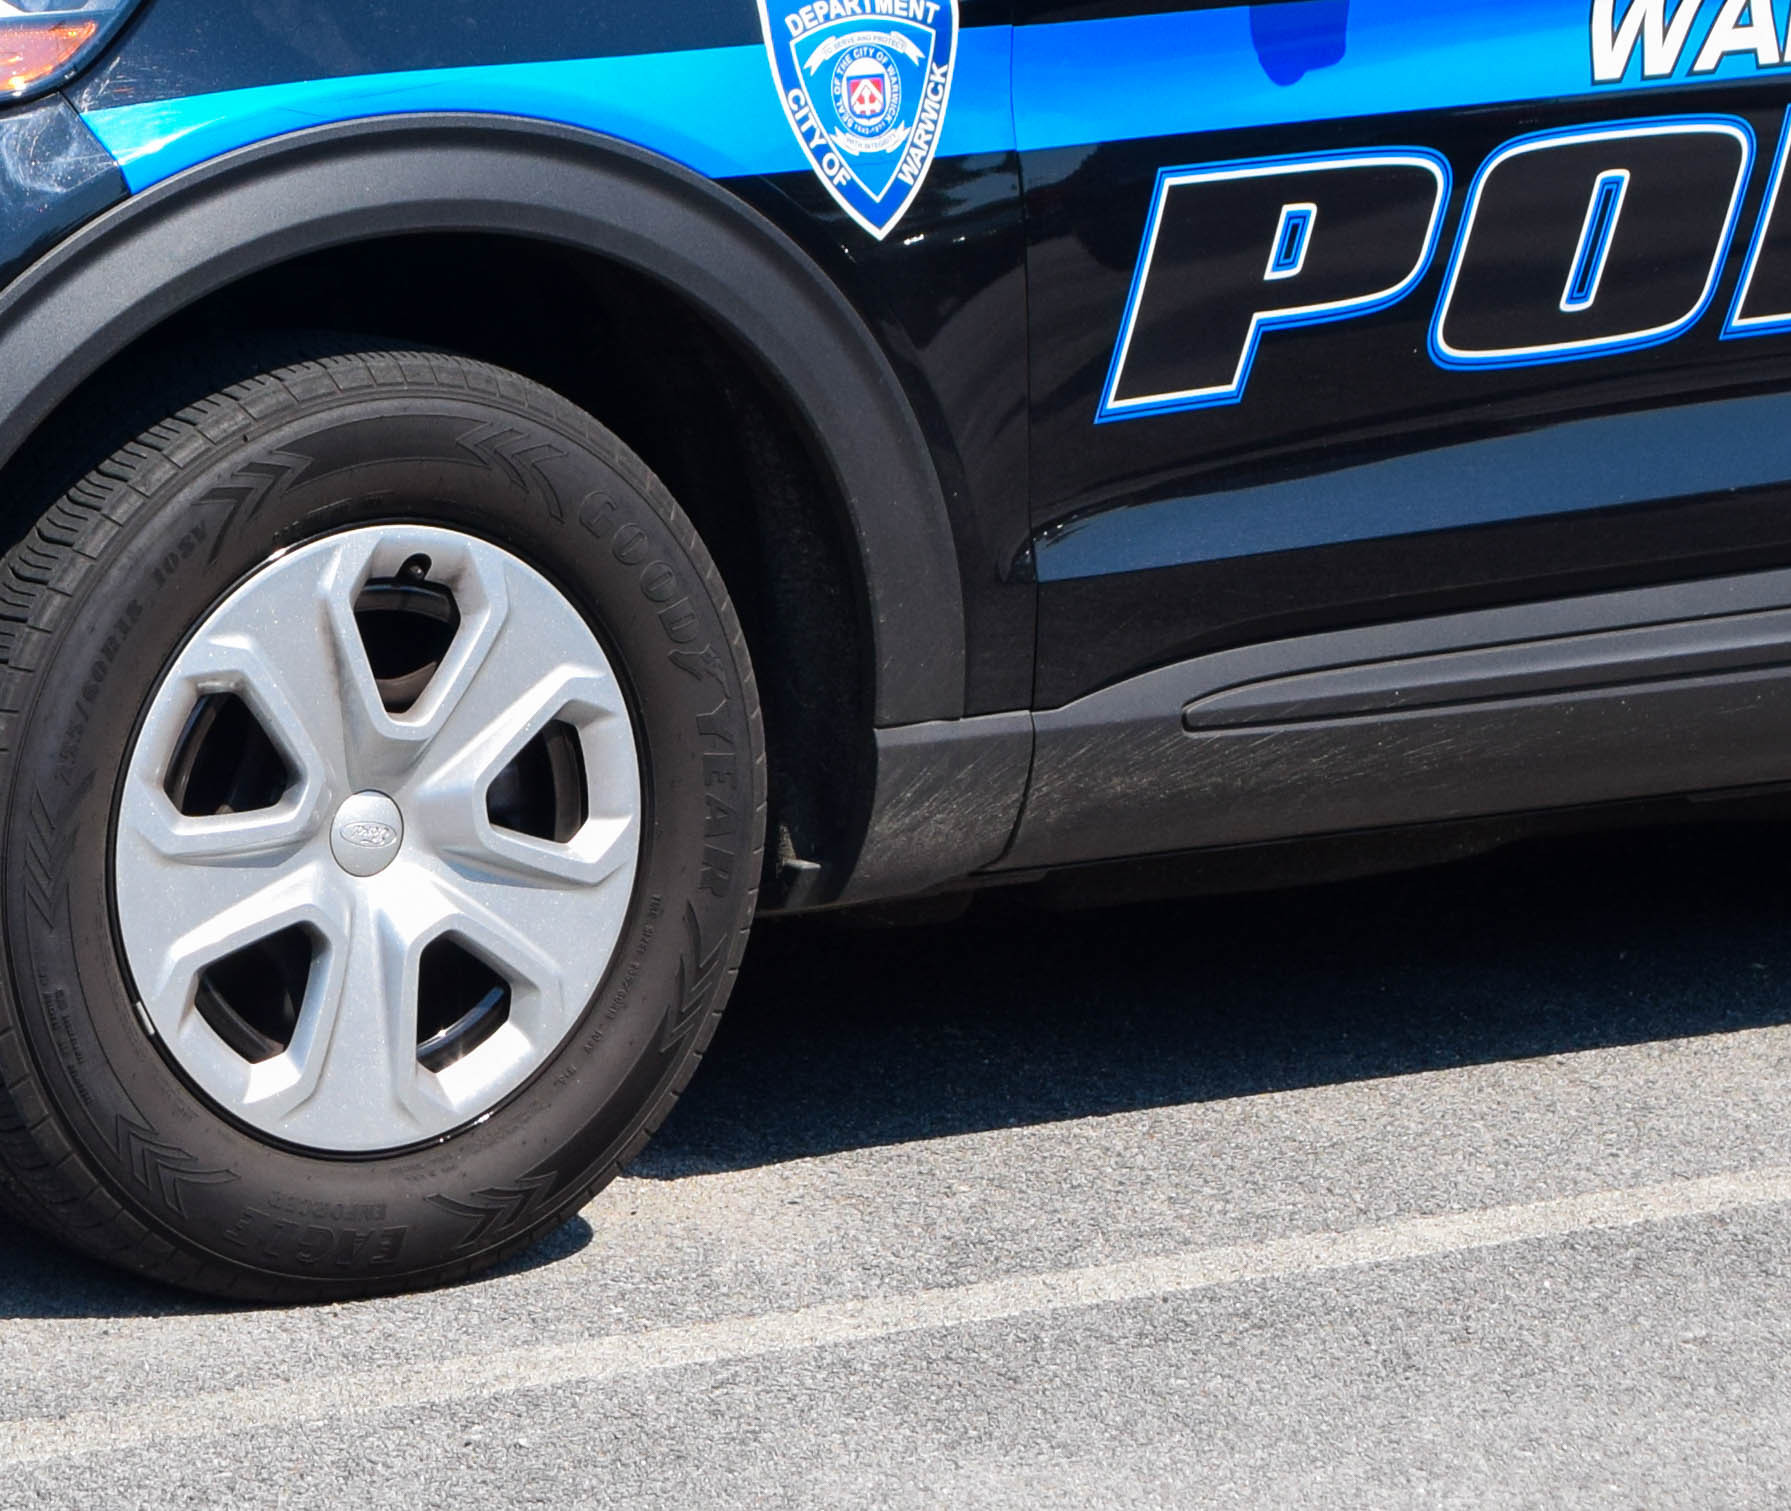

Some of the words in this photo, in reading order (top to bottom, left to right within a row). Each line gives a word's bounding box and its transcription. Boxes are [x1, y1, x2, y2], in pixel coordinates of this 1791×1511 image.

[836, 53, 853, 75] THE
[852, 47, 876, 58] CITY
[786, 87, 828, 154] CITY
[822, 151, 851, 188] OF
[898, 63, 949, 186] WARWICK
